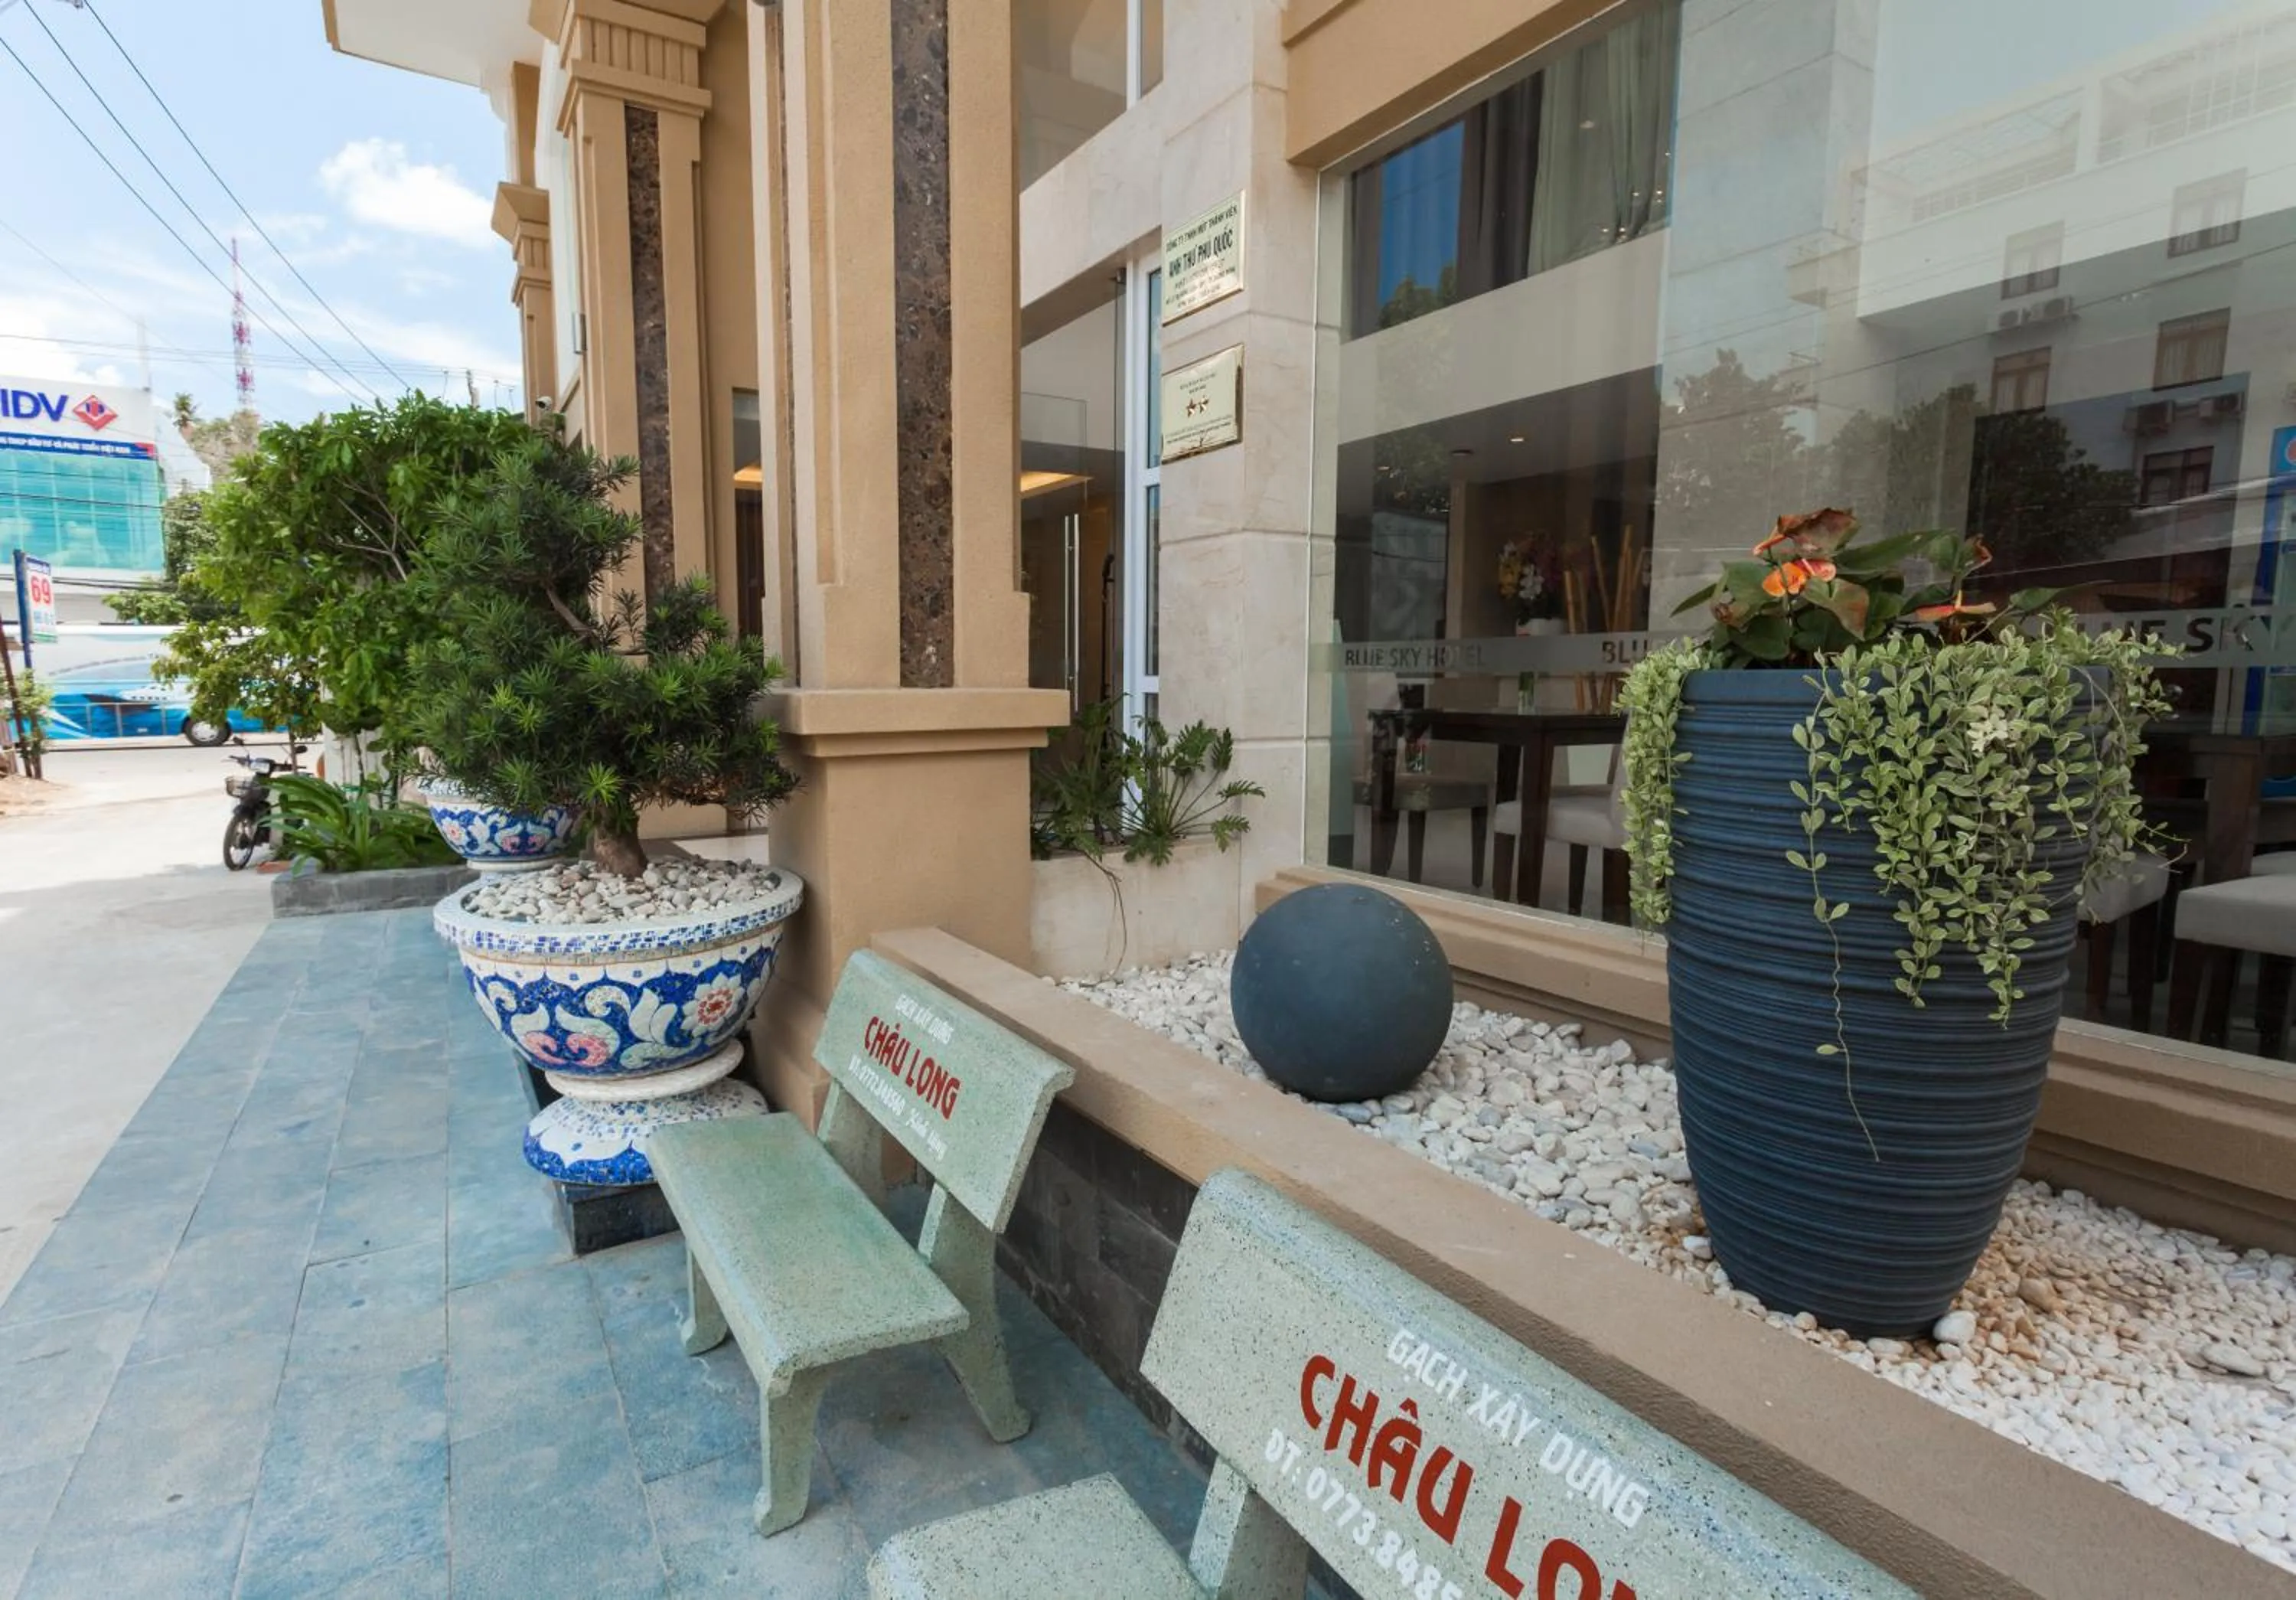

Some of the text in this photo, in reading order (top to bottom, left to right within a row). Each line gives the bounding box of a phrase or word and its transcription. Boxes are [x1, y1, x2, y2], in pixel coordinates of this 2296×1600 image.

[31, 575, 51, 605] 69
[1389, 646, 1423, 668] SKY
[1601, 638, 1650, 664] BLU
[905, 1048, 960, 1120] LONG
[1386, 1328, 1651, 1530] GẠCH XÂY DỰNG
[1300, 1353, 1637, 1600] CHÂU LO
